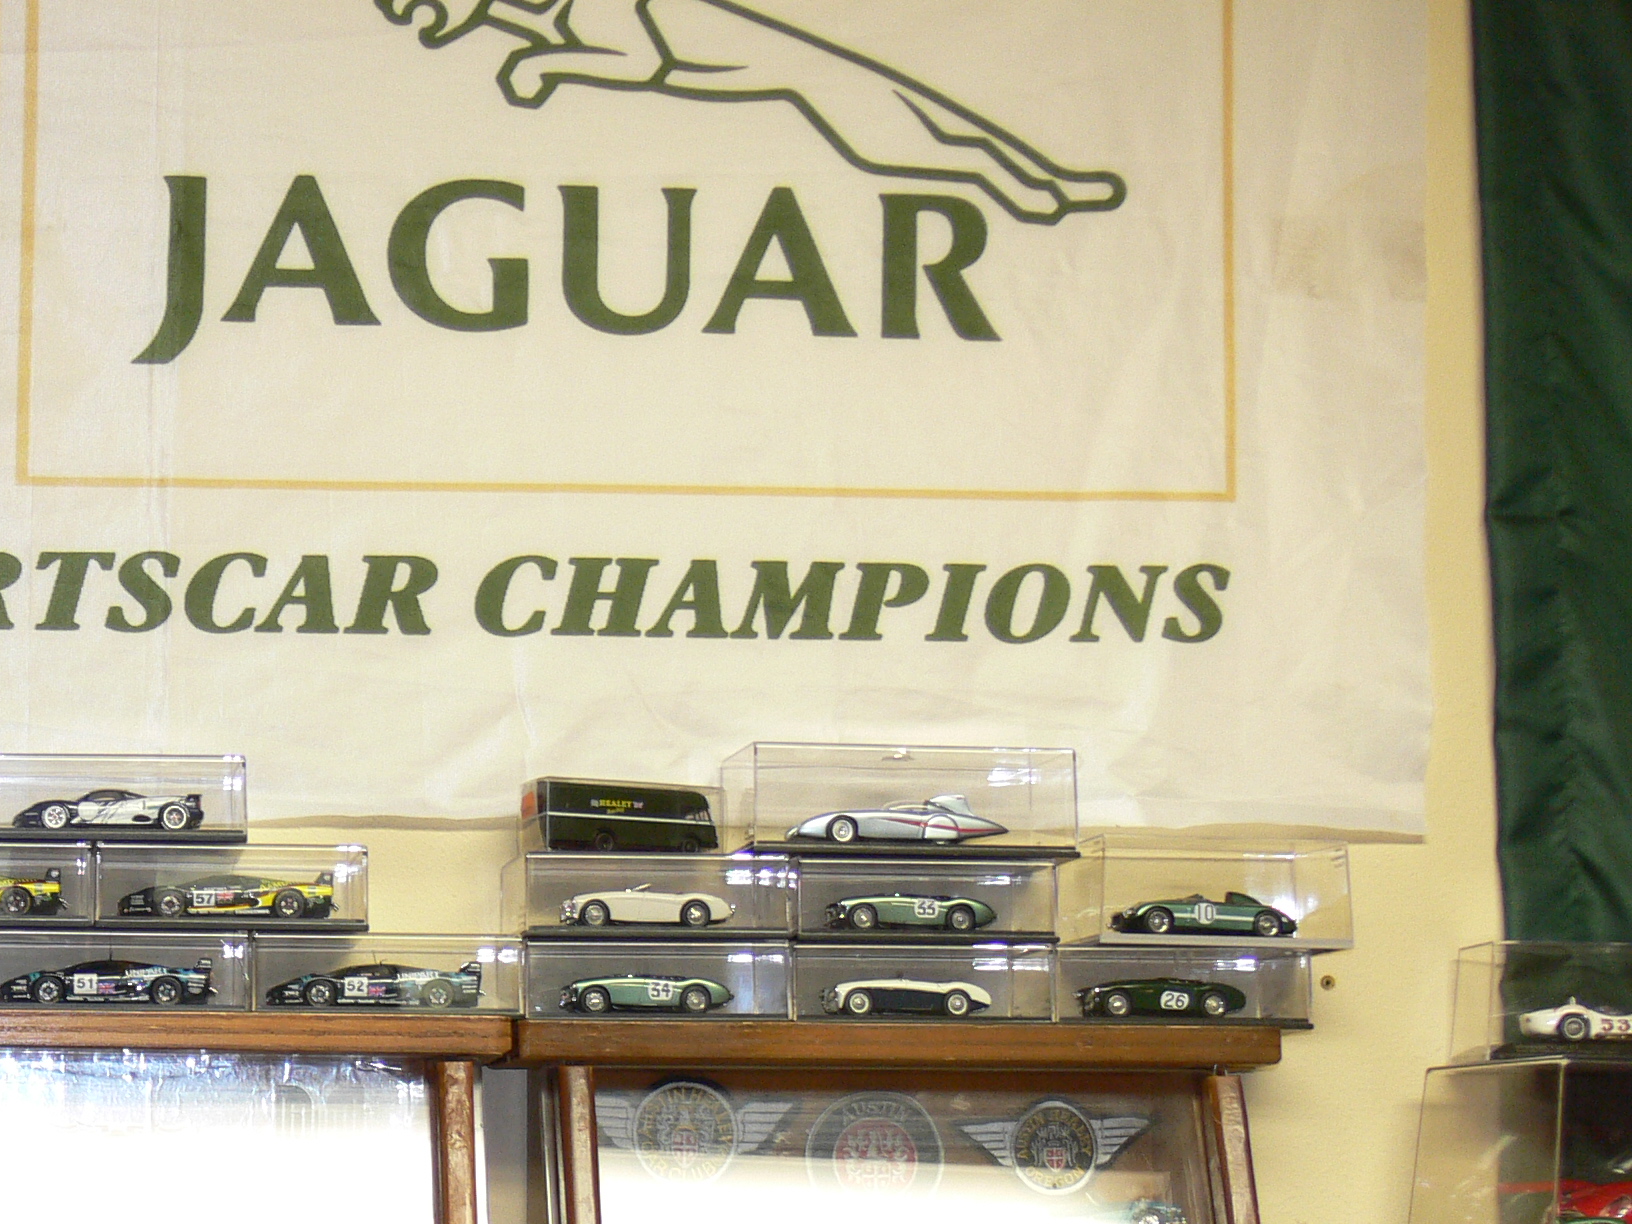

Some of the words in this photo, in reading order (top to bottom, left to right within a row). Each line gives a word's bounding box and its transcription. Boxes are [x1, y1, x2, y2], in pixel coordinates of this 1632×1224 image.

[131, 173, 1003, 365] JAGUAR
[473, 555, 1230, 645] CHAMPIONS
[599, 798, 634, 809] HEALEY
[195, 893, 214, 905] 57
[916, 900, 938, 916] 33
[1197, 902, 1214, 921] 10
[125, 965, 169, 977] UNIPART
[396, 968, 439, 981] UNIPART
[76, 977, 94, 990] 51
[346, 980, 365, 993] 52
[650, 982, 672, 998] 34
[1163, 992, 1188, 1009] 26
[1600, 1018, 1631, 1032] 53
[841, 1101, 909, 1125] AUSTIN
[1018, 1110, 1047, 1159] AUSTIN
[1025, 1163, 1085, 1189] OREGON
